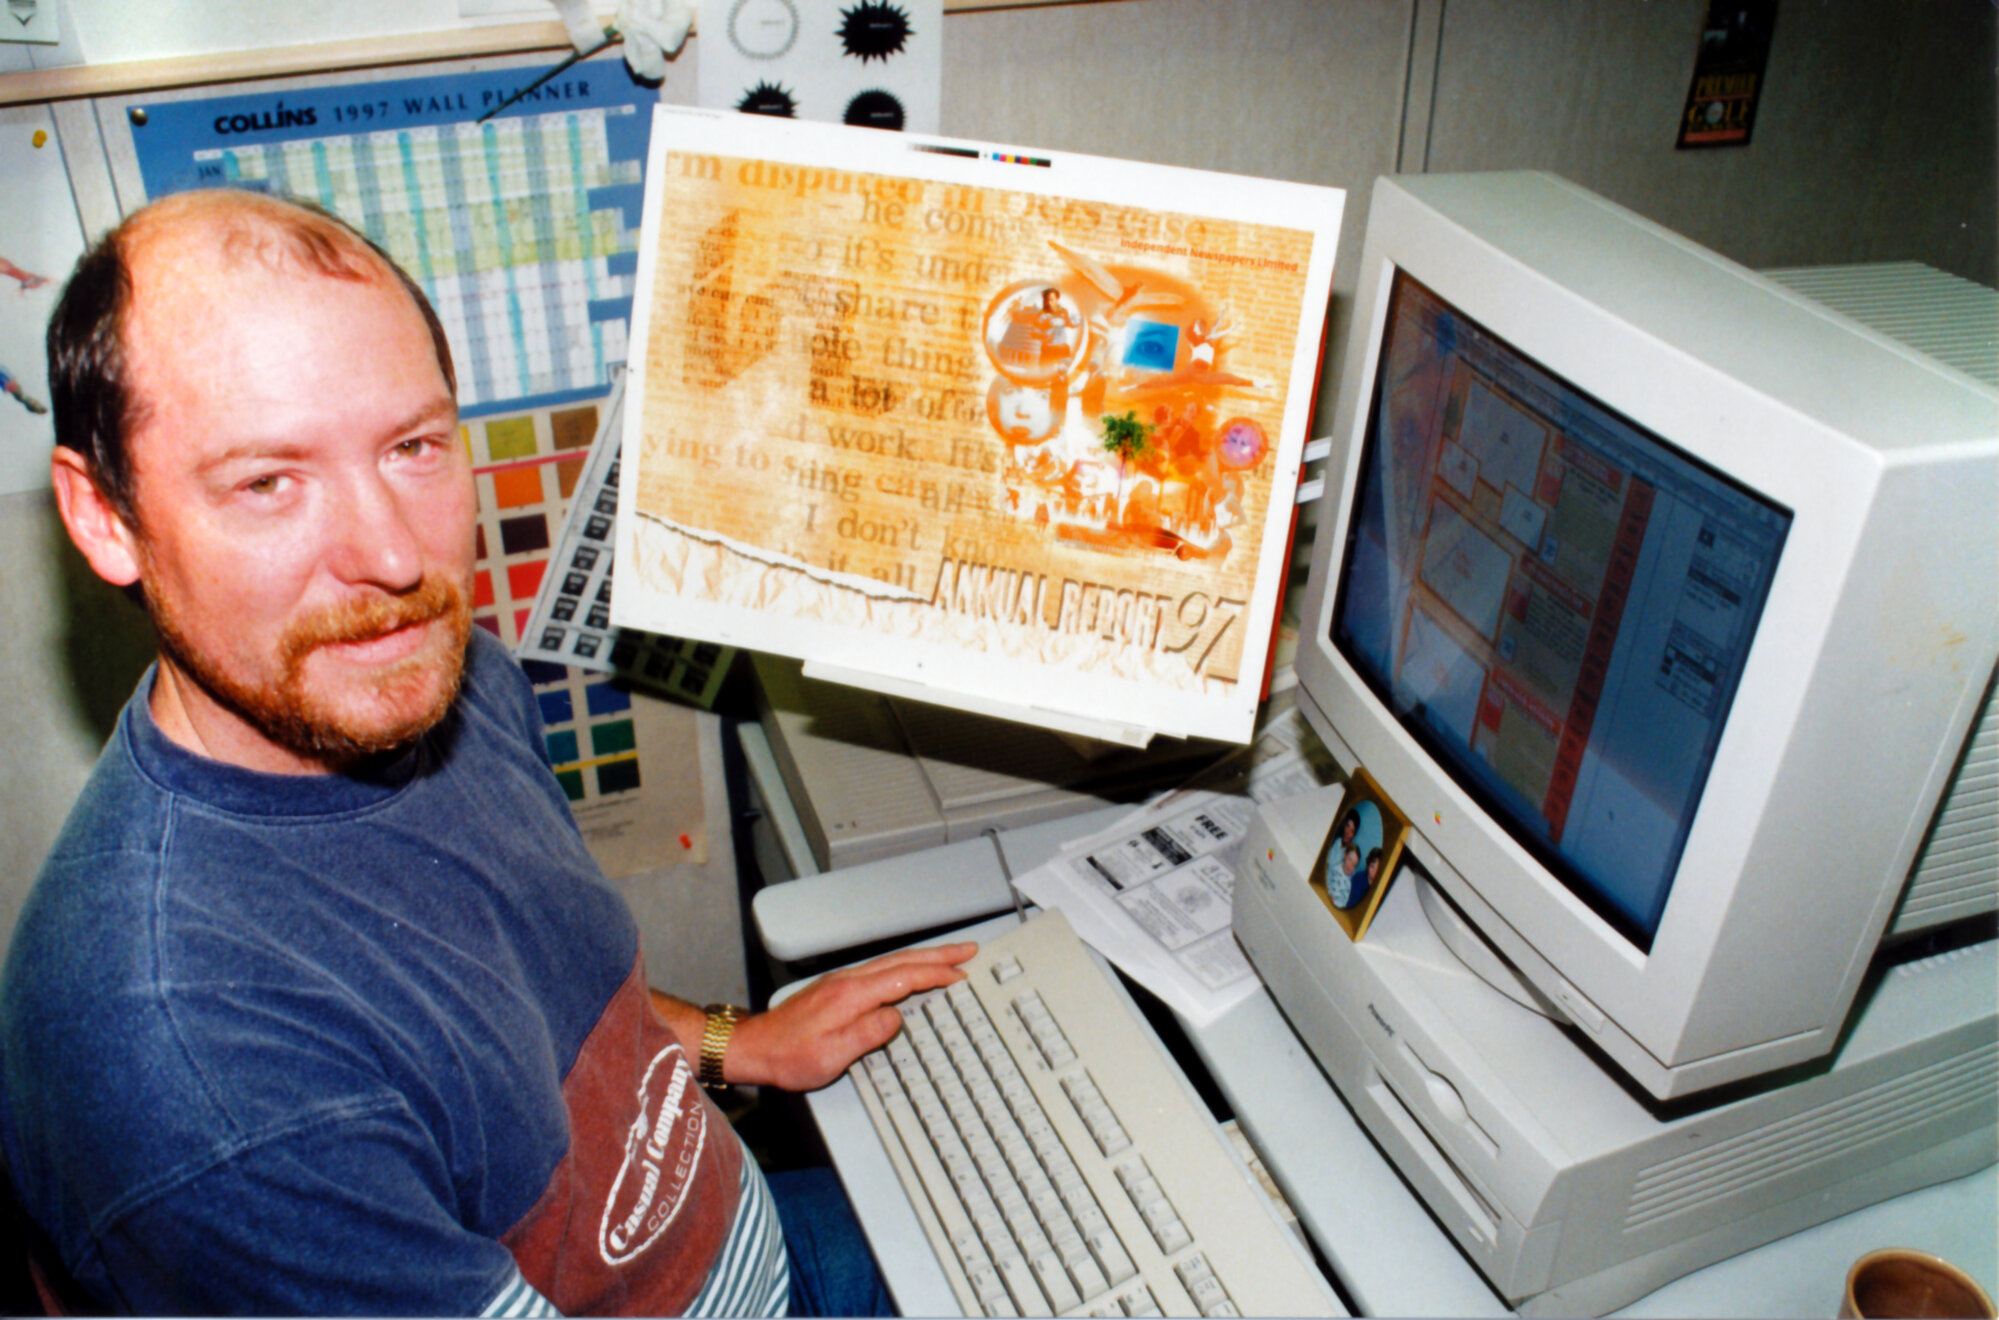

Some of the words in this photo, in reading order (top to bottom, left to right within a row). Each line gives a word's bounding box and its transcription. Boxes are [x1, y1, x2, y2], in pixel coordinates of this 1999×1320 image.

[333, 102, 390, 122] 1997
[404, 91, 467, 115] WALL
[482, 80, 591, 108] PLANNER
[861, 190, 905, 226] he
[842, 236, 896, 274] it's
[1120, 237, 1188, 258] Independent
[1189, 247, 1256, 270] Newspapers
[1257, 255, 1299, 273] Limited
[836, 285, 941, 325] share
[735, 442, 771, 473] to
[804, 503, 818, 533] I
[837, 508, 922, 552] don't
[932, 556, 1060, 632] ANNUAL
[1060, 578, 1176, 650] REPORT
[1166, 591, 1247, 674] 97
[1193, 813, 1231, 841] FREE
[646, 1101, 704, 1233] COLLECTION
[609, 1162, 661, 1251] Casual
